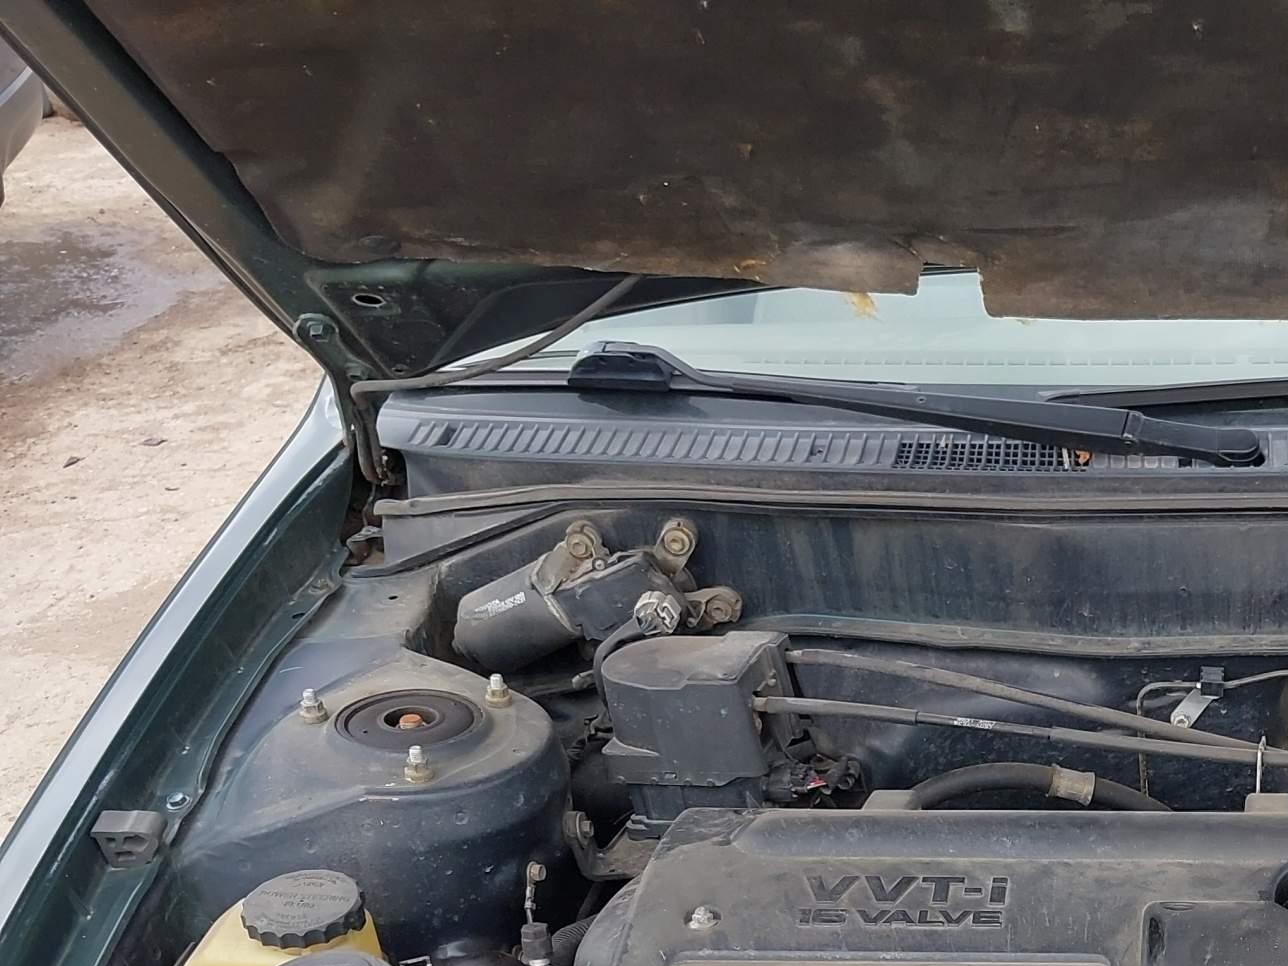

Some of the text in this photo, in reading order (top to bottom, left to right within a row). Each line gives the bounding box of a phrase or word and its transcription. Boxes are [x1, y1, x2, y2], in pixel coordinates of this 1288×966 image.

[803, 875, 1009, 907] VVT-i
[798, 908, 1004, 929] 16 VALVE
